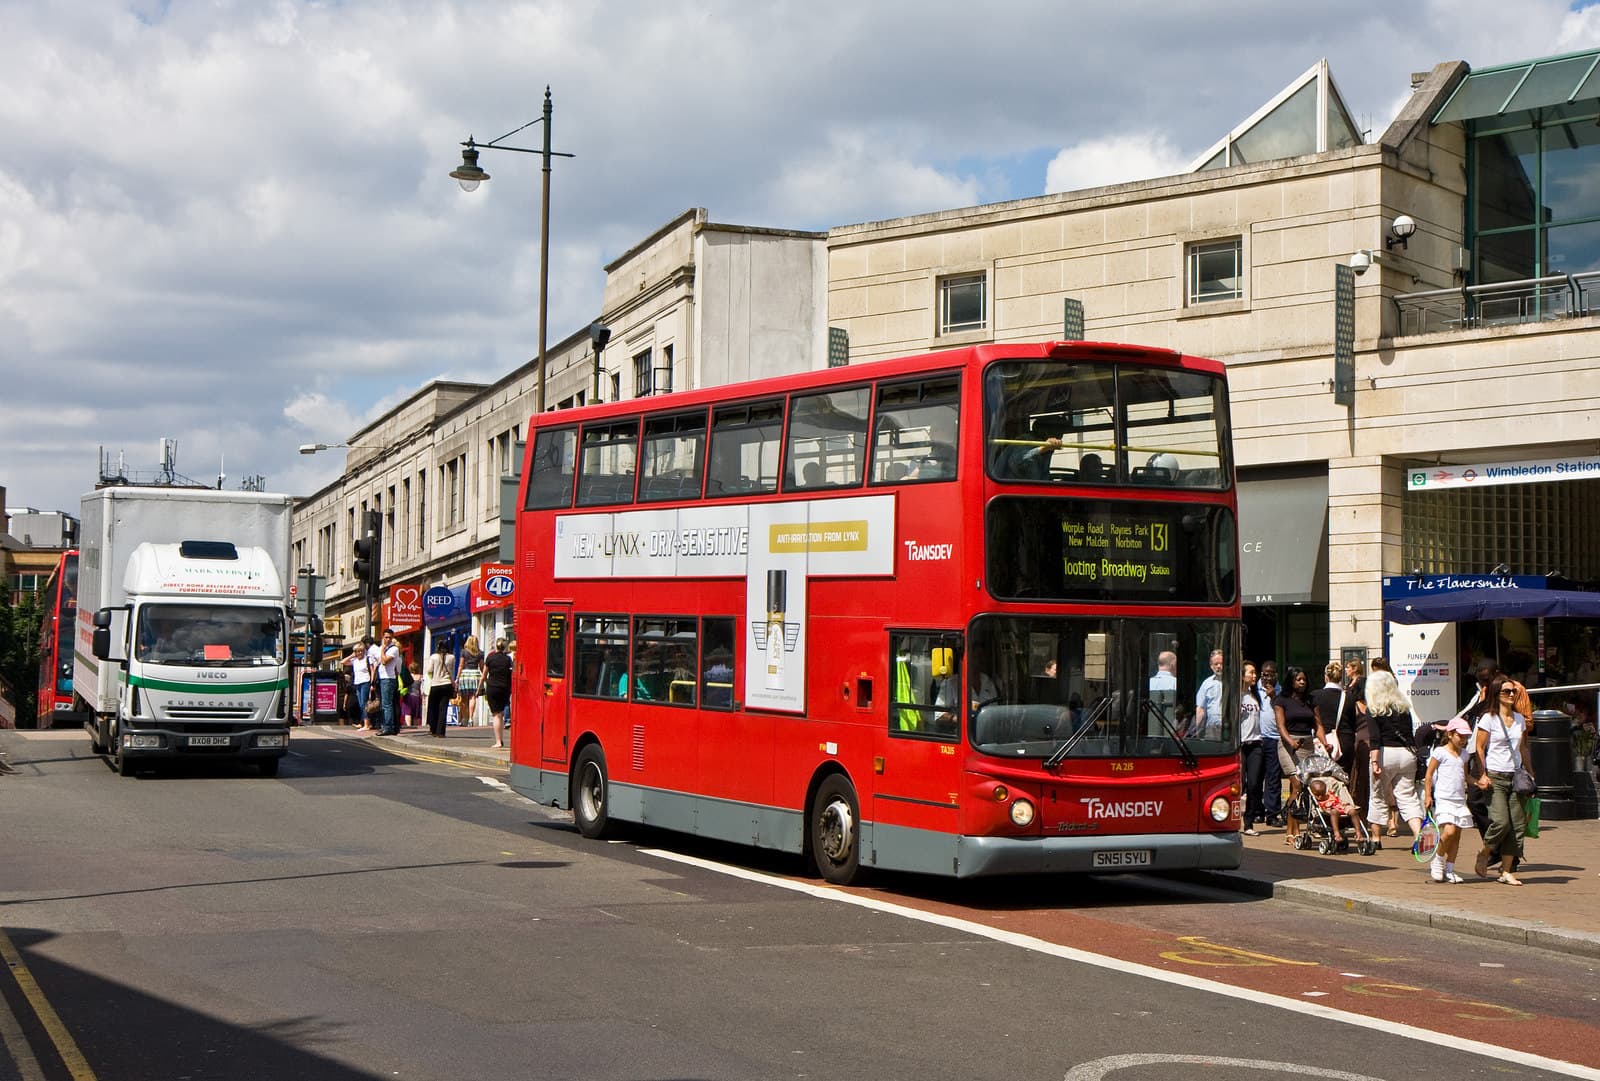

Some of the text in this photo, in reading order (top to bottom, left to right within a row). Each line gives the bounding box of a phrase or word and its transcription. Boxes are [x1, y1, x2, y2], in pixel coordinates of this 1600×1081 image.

[1486, 460, 1600, 478] Wimbledon Station
[823, 531, 842, 542] FROM
[843, 531, 860, 541] LYNX
[1061, 521, 1149, 538] Worple Road Raynes Park
[1151, 523, 1168, 551] 131
[572, 533, 595, 558] NEW
[604, 533, 640, 556] LYNX
[1068, 535, 1143, 549] New Malden Norbiton
[904, 540, 953, 561] TRANSDEV
[487, 567, 513, 576] phones
[1063, 558, 1170, 583] Tooting Broadway Station
[1406, 579, 1434, 591] The
[427, 595, 452, 605] REED
[197, 671, 228, 679] IVECO
[1080, 798, 1164, 819] TRANSDEV
[1096, 851, 1148, 865] SN51 SYU
